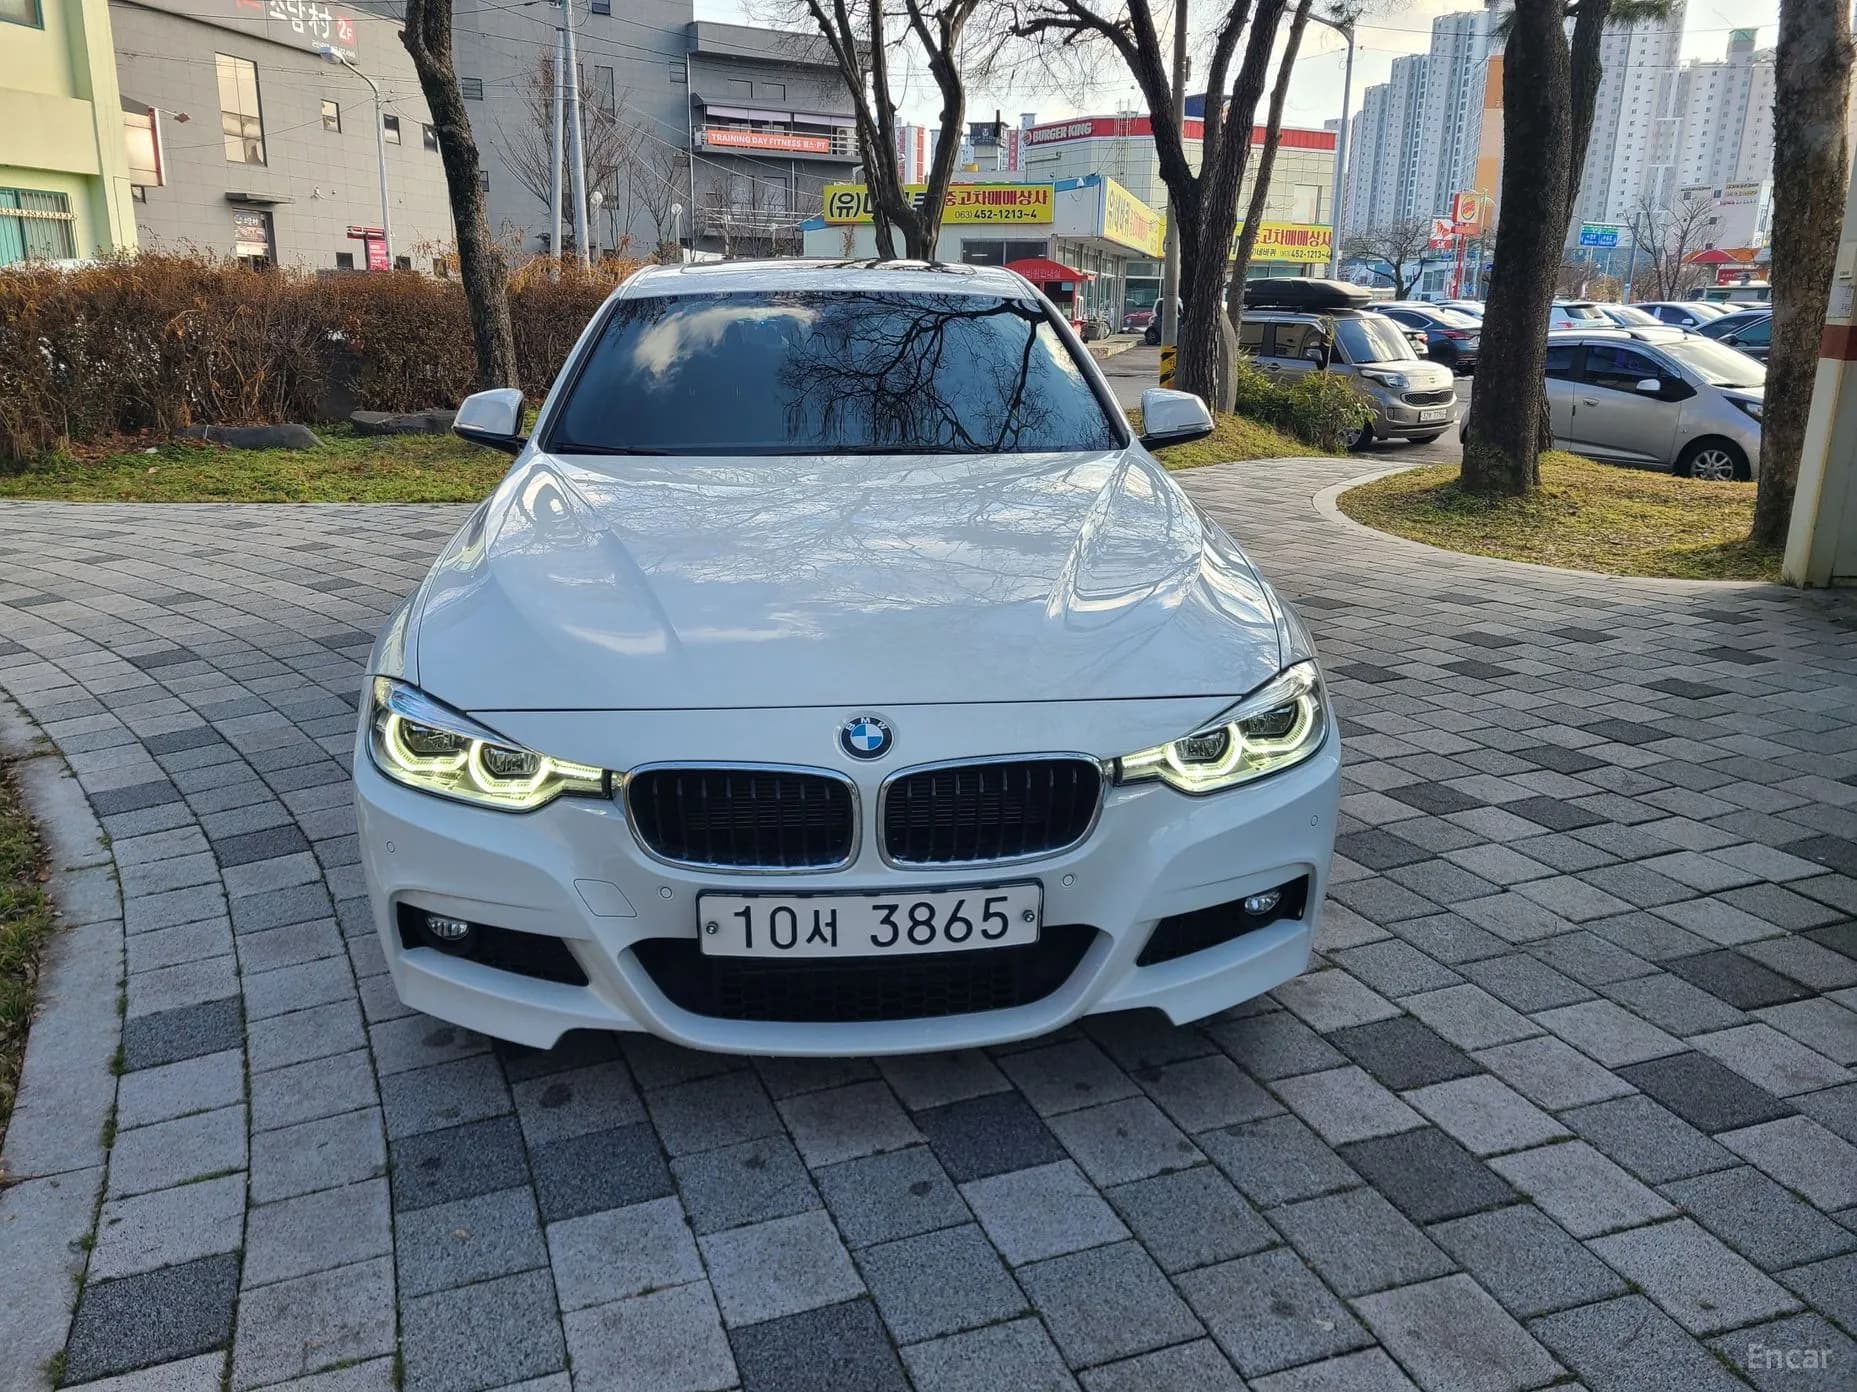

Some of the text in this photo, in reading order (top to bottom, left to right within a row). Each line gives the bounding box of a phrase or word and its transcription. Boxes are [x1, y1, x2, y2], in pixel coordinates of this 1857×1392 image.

[711, 133, 751, 145] TRAINING
[752, 136, 768, 146] DAY
[769, 137, 801, 148] FITNESS
[1032, 122, 1093, 143] BURGER KING
[944, 189, 1049, 207] 중고차매매상사
[733, 895, 1009, 950] 10서 3865
